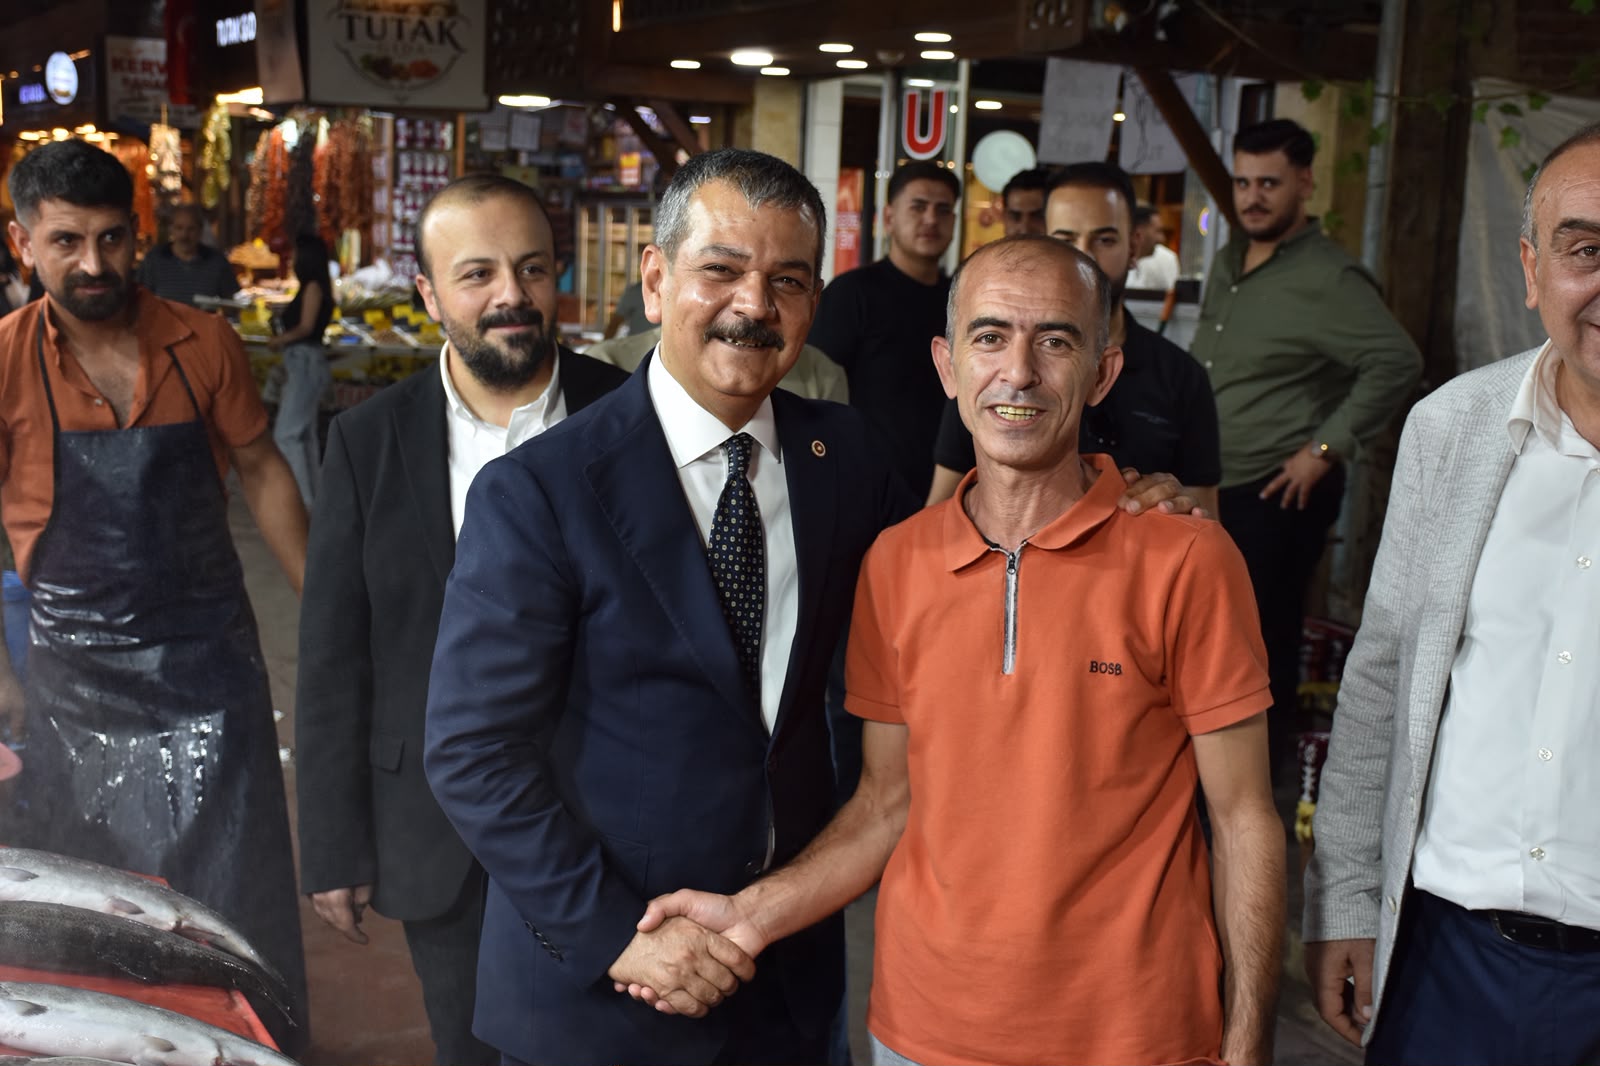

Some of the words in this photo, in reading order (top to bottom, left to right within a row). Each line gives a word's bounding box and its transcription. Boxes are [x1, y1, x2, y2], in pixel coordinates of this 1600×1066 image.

[338, 12, 466, 53] TUTAK
[110, 56, 167, 74] KERV
[902, 89, 948, 160] U
[1089, 660, 1122, 676] BOSB
